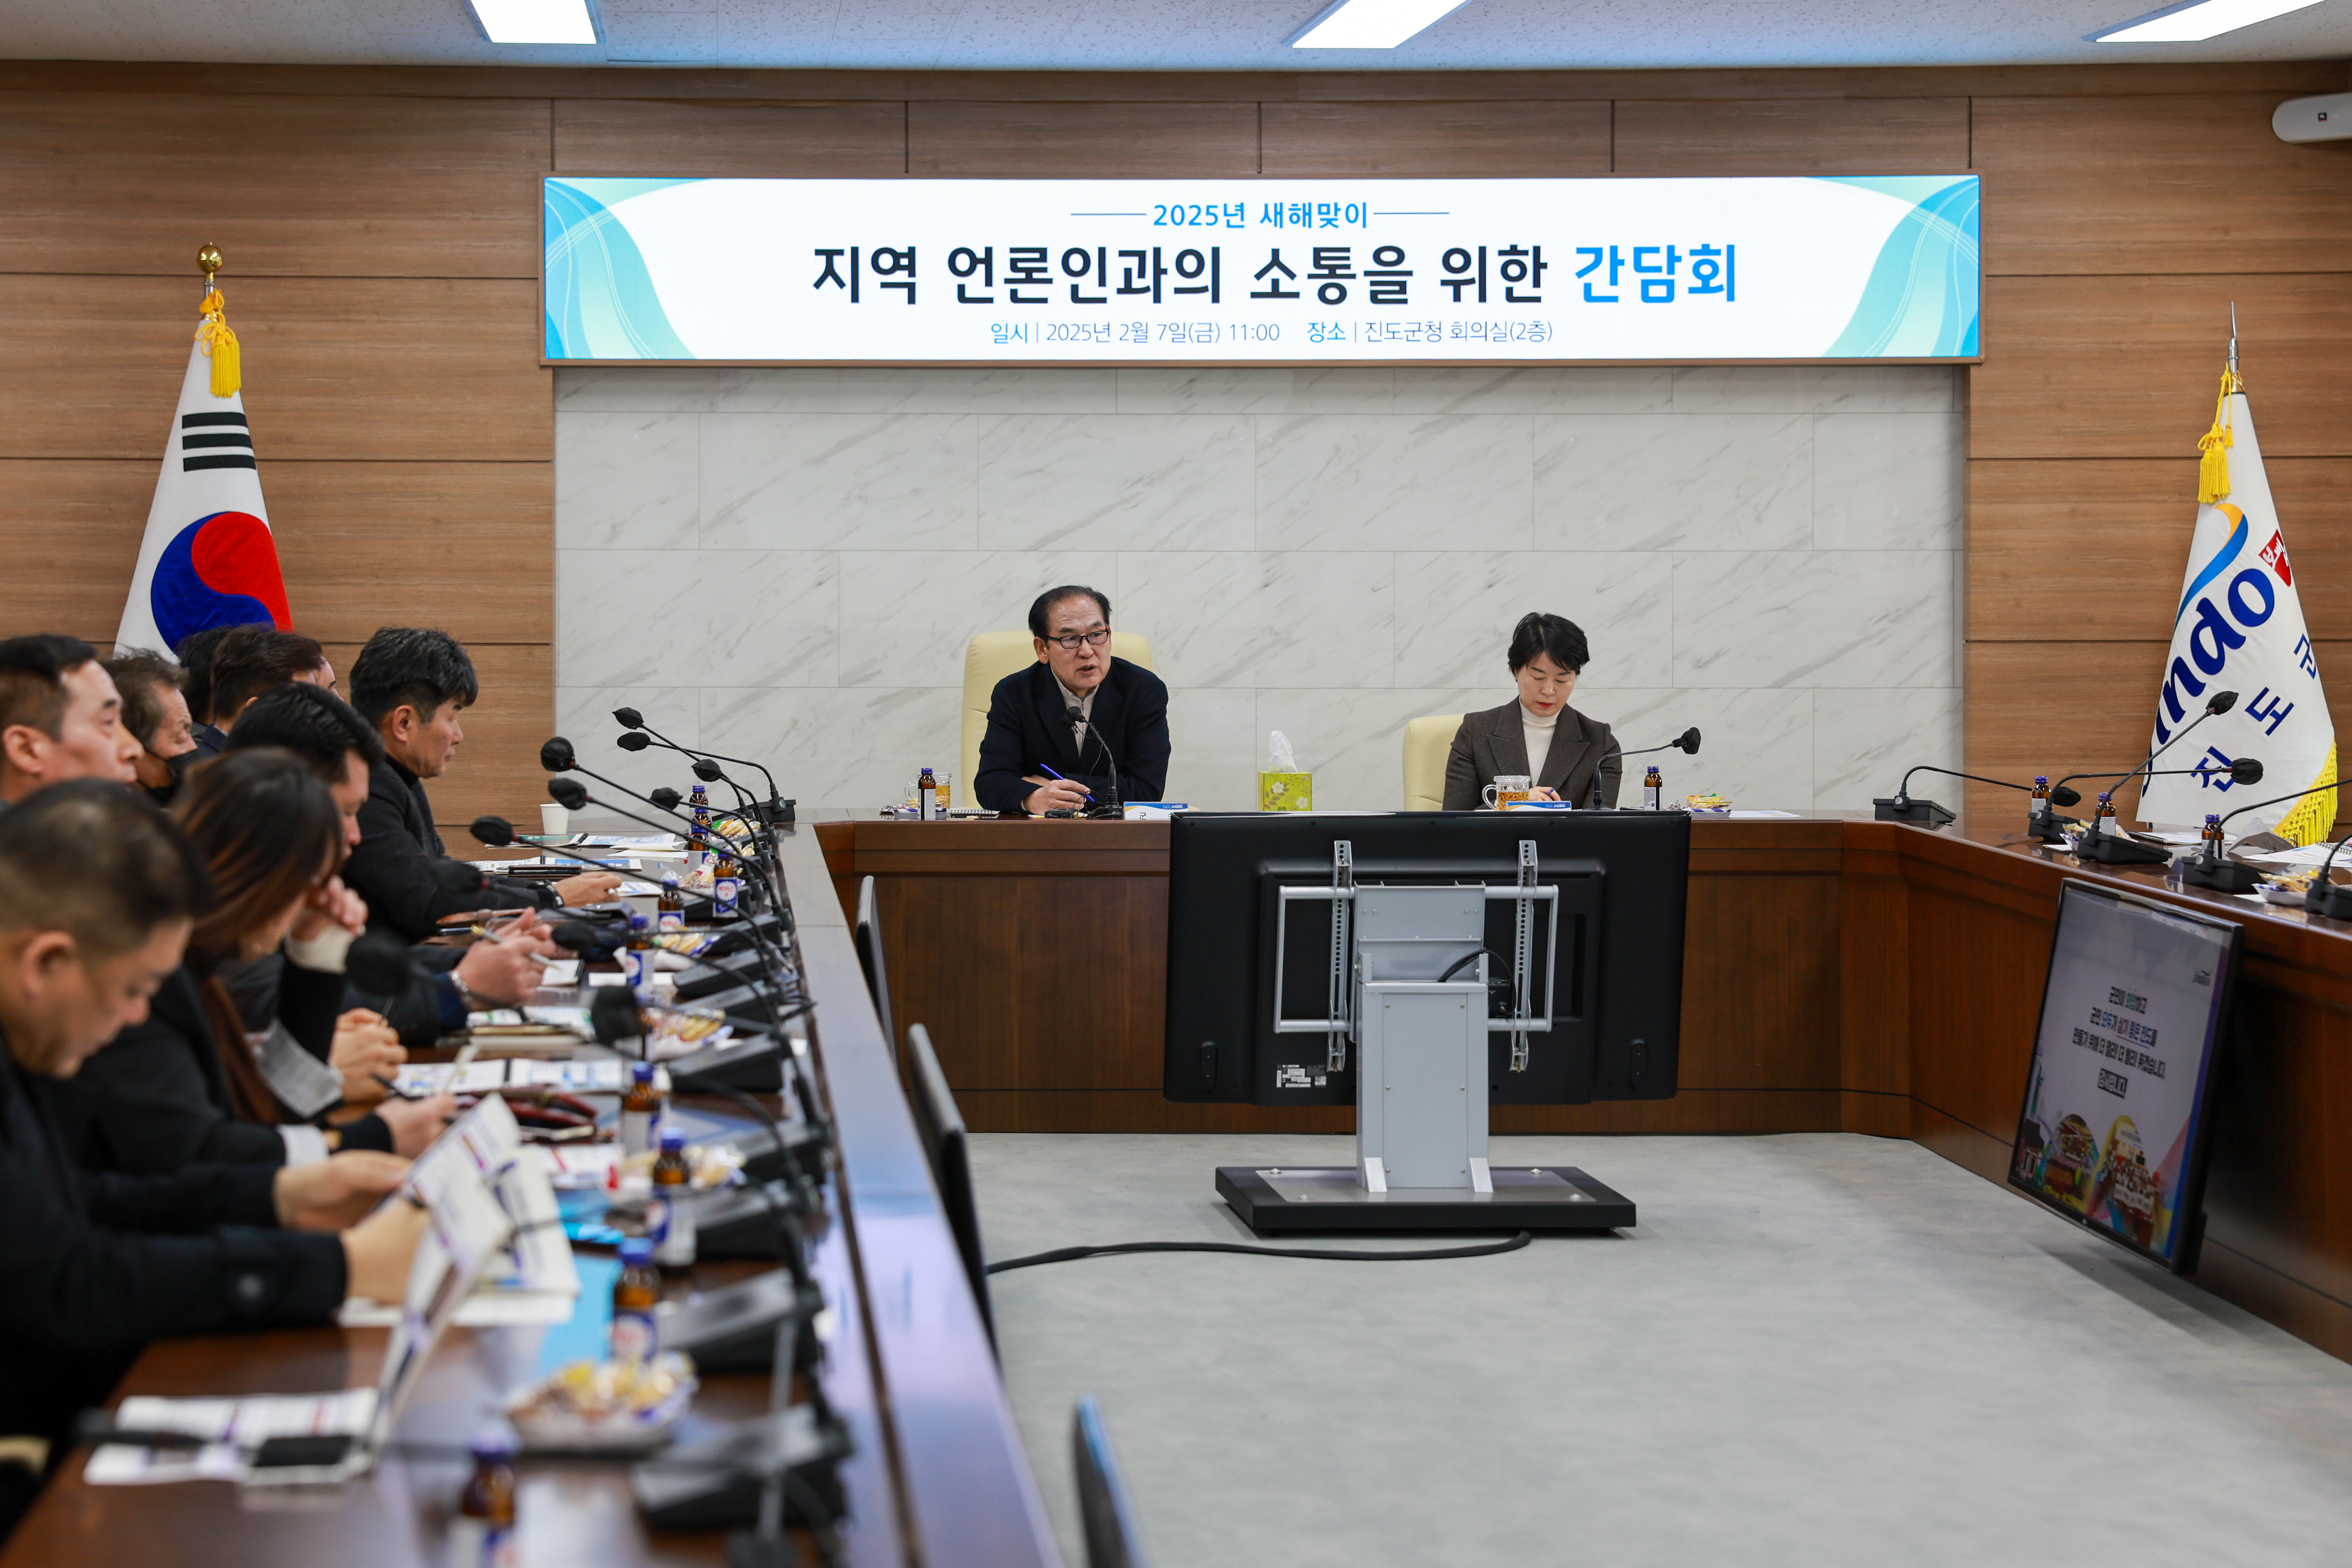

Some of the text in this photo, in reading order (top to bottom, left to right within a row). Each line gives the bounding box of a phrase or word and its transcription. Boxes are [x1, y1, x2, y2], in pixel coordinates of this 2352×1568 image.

[1153, 201, 1367, 229] 2025년 새해맞이
[812, 243, 1735, 306] 지역 언론인과의 소통을 위한 간담회
[991, 321, 1552, 344] 일시 2025년 2월 7일(금) 11:00 장소 진도군청 회의실(2층)
